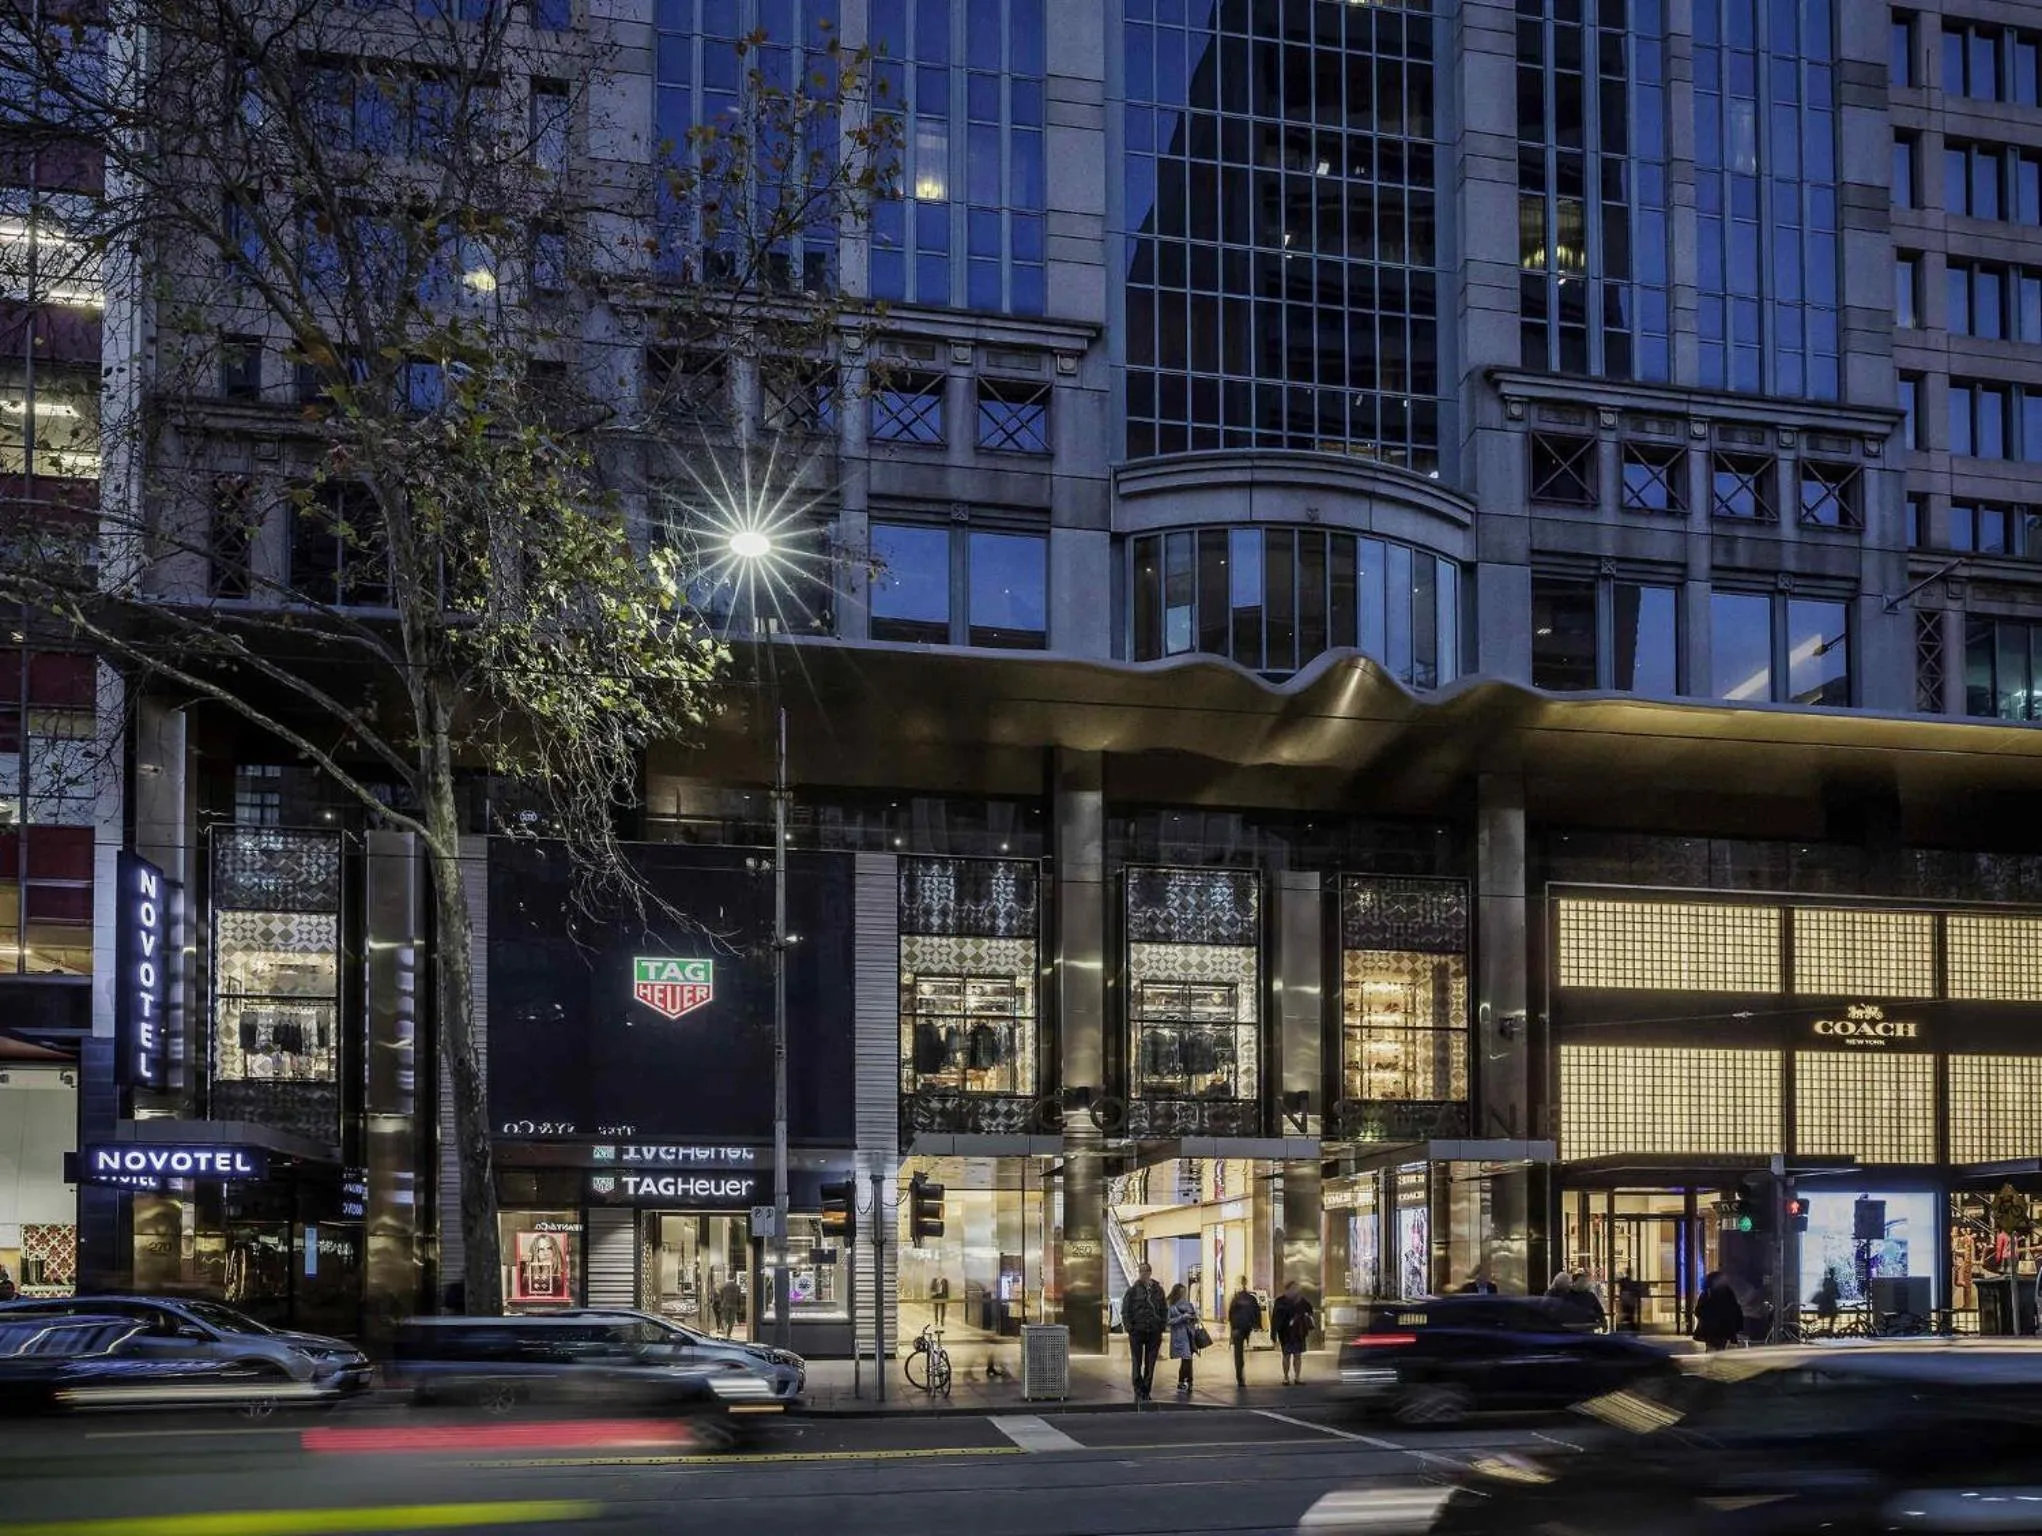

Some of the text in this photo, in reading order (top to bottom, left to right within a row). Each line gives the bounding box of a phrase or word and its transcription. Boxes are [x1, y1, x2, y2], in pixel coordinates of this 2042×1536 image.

[139, 868, 157, 1078] NOVOTEL
[641, 962, 704, 980] TAG
[639, 985, 708, 1014] HEUER
[1814, 1021, 1917, 1037] COACH
[98, 1150, 251, 1171] NOVOTEL
